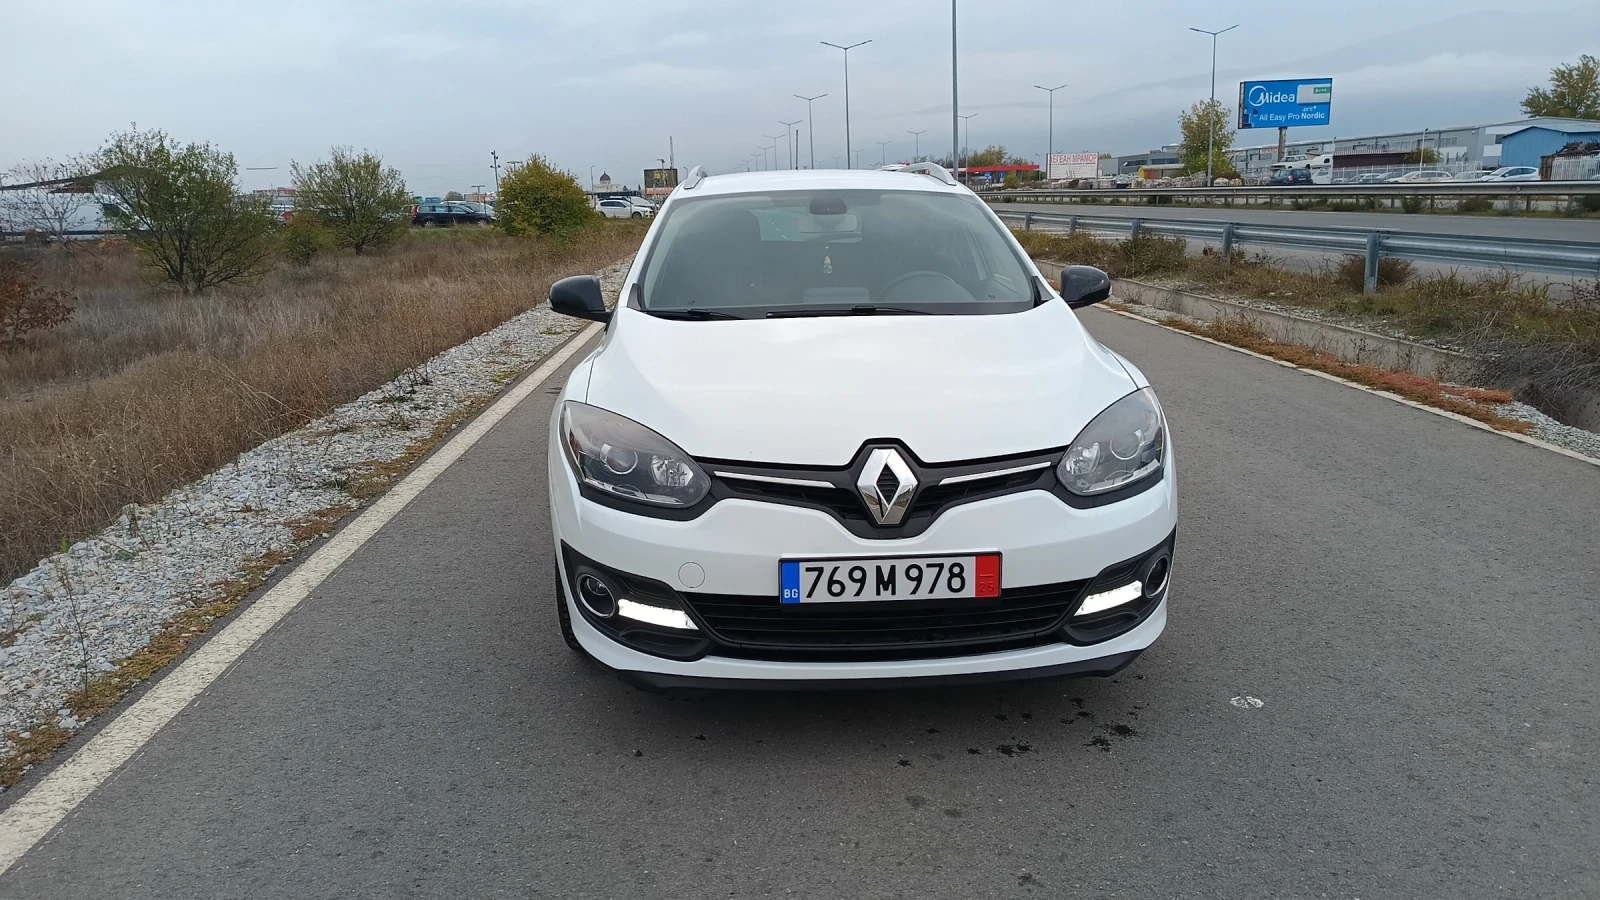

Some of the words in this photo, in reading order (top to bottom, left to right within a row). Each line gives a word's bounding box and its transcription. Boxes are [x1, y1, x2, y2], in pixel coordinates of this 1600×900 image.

[1253, 91, 1295, 104] Midea
[1269, 113, 1286, 122] Easy
[1288, 112, 1300, 120] Pro
[1301, 112, 1325, 120] Nordic
[805, 566, 867, 598] 769
[875, 565, 896, 596] M
[905, 562, 966, 595] 978
[784, 588, 798, 598] BG
